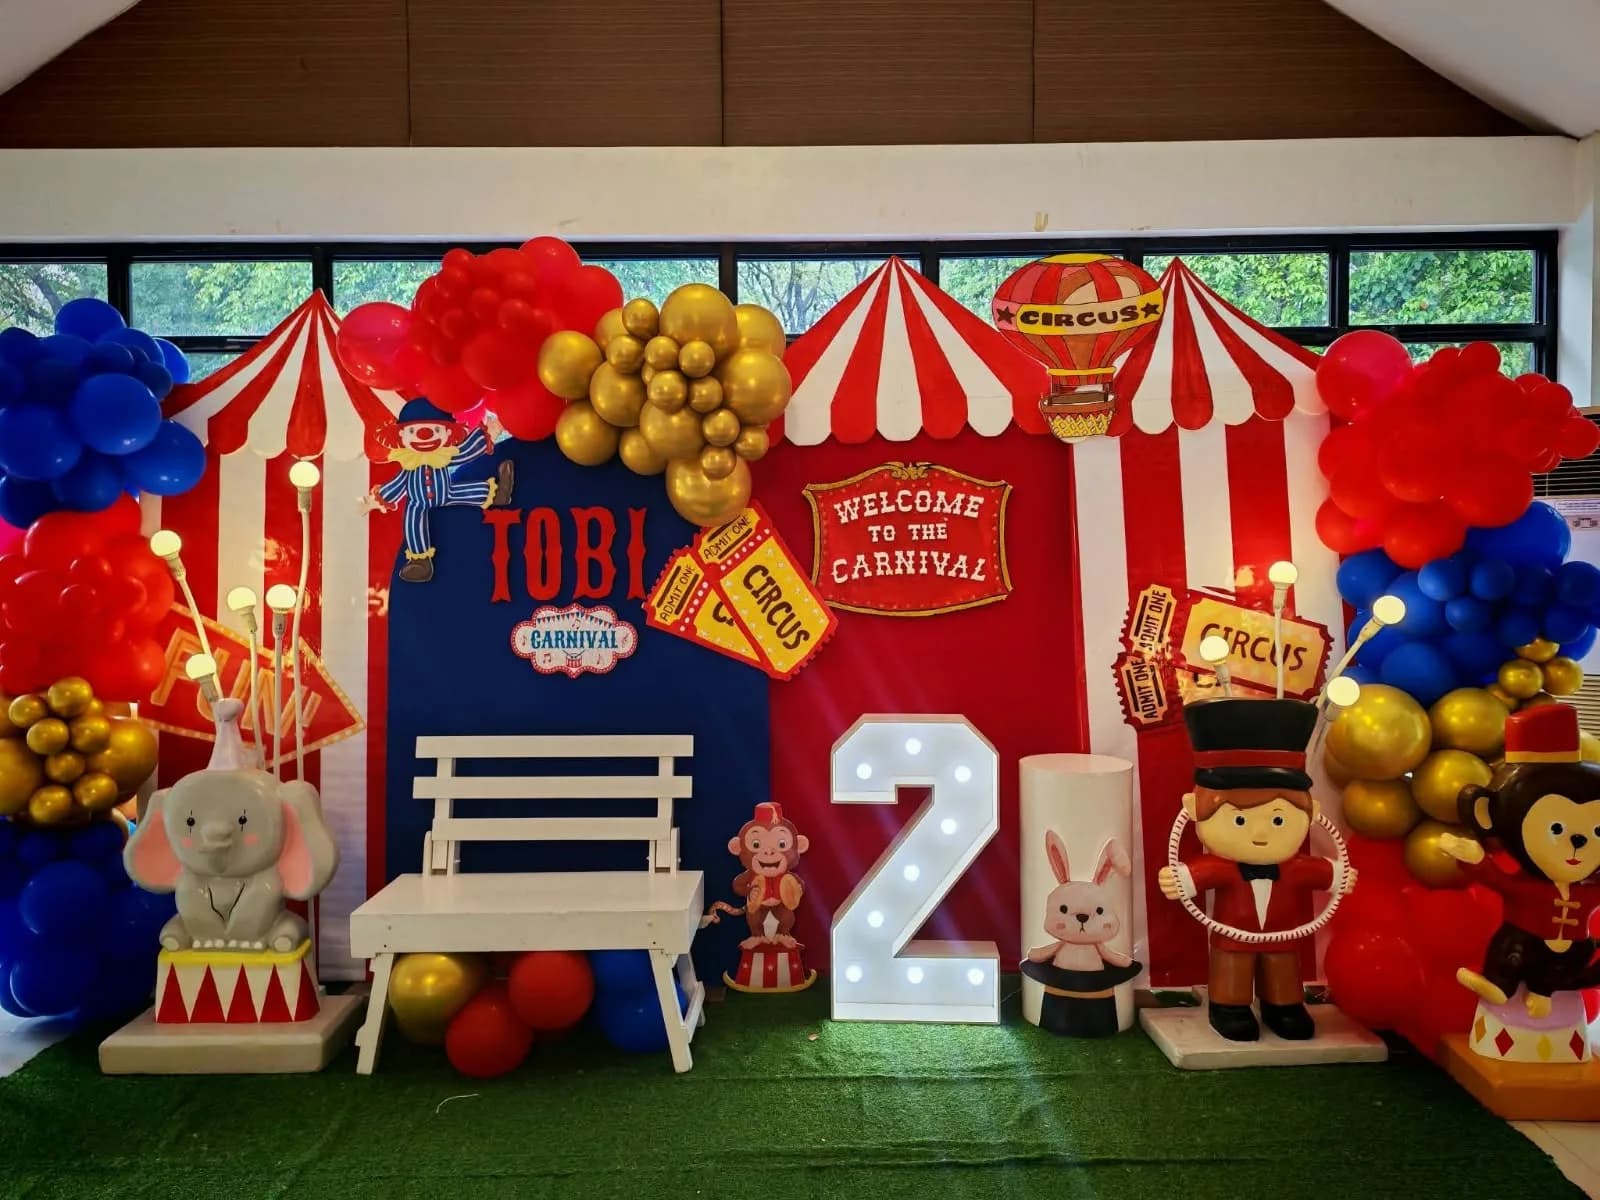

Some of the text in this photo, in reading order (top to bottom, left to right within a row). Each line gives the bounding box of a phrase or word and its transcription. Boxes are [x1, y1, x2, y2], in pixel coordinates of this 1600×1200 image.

[1019, 305, 1139, 327] CIRCUS
[833, 490, 985, 524] WELCOME
[868, 522, 948, 542] TO THE
[482, 506, 648, 602] TOBI
[703, 514, 752, 560] ADMIT ONE
[831, 550, 986, 583] CARNIVAL
[660, 564, 695, 622] ADMIT ONE
[743, 565, 810, 650] CIRCUS
[530, 630, 618, 649] CARNIVAL
[1139, 590, 1167, 651] ADMIT ONE
[1131, 656, 1159, 719] ADMIT ONE
[831, 713, 999, 1024] 2
